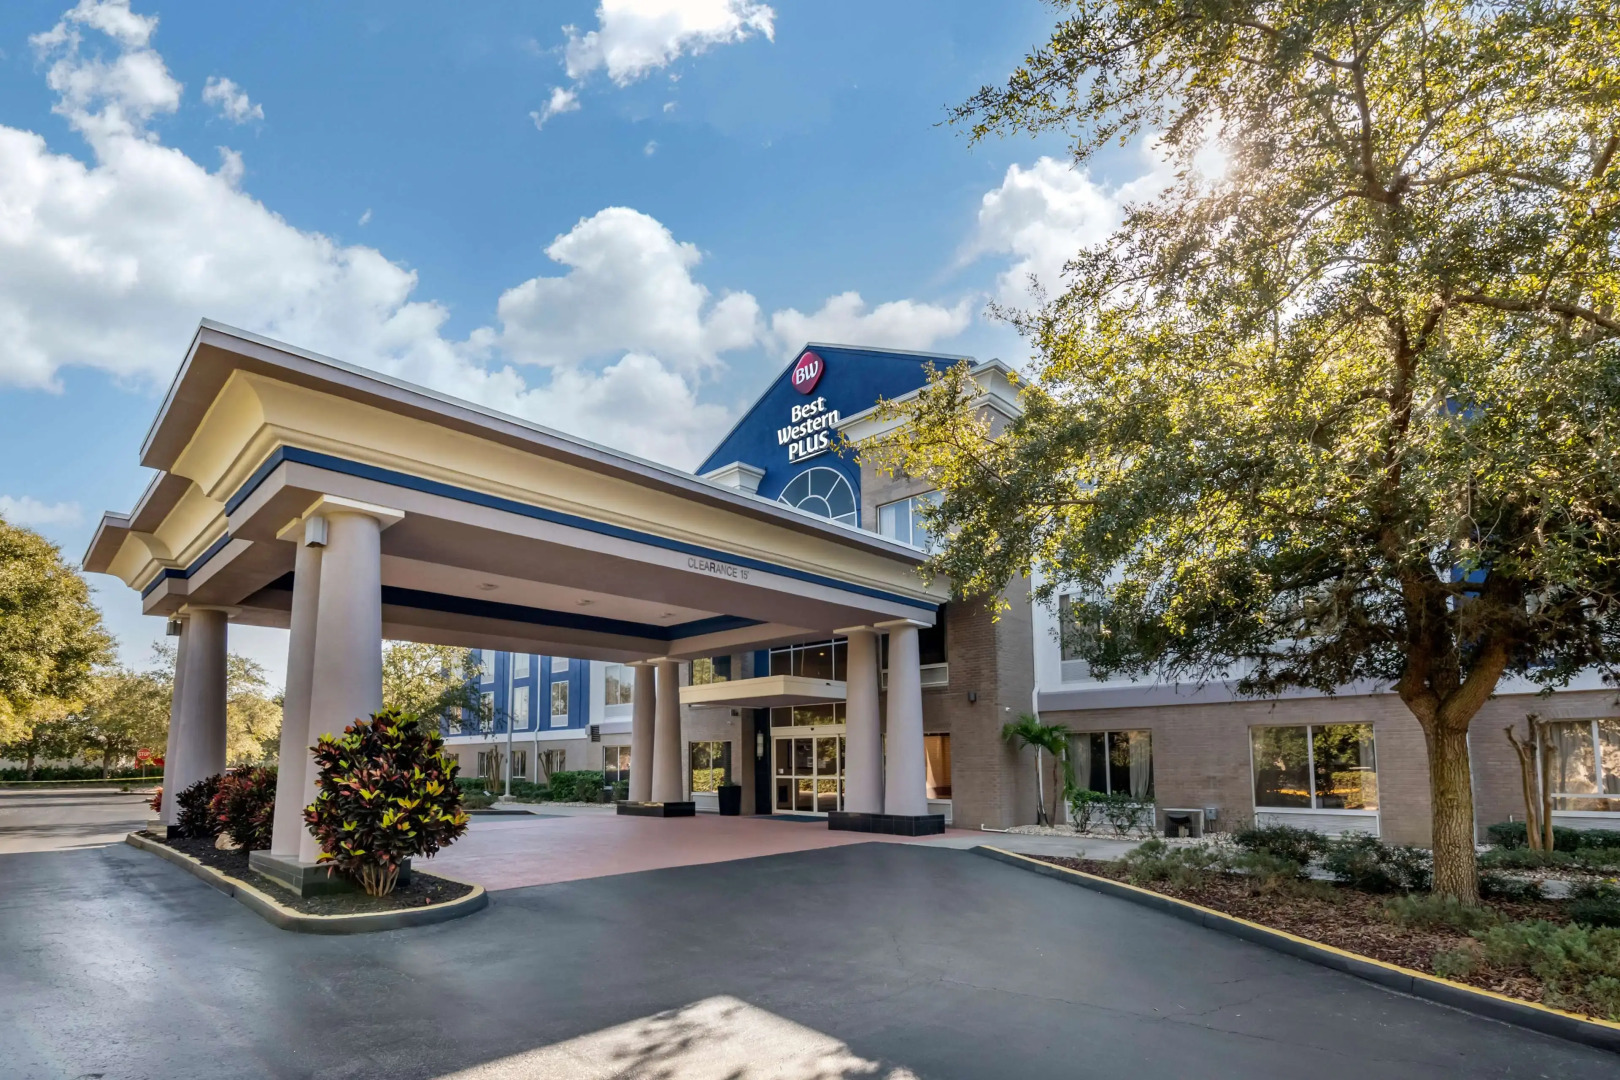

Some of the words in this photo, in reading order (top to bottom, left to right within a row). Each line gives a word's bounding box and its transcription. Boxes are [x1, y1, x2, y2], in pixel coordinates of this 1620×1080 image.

[795, 360, 818, 385] BW
[791, 396, 826, 423] Best
[777, 409, 839, 446] Western
[788, 430, 829, 461] PLUS
[687, 557, 738, 578] CLEARANCE
